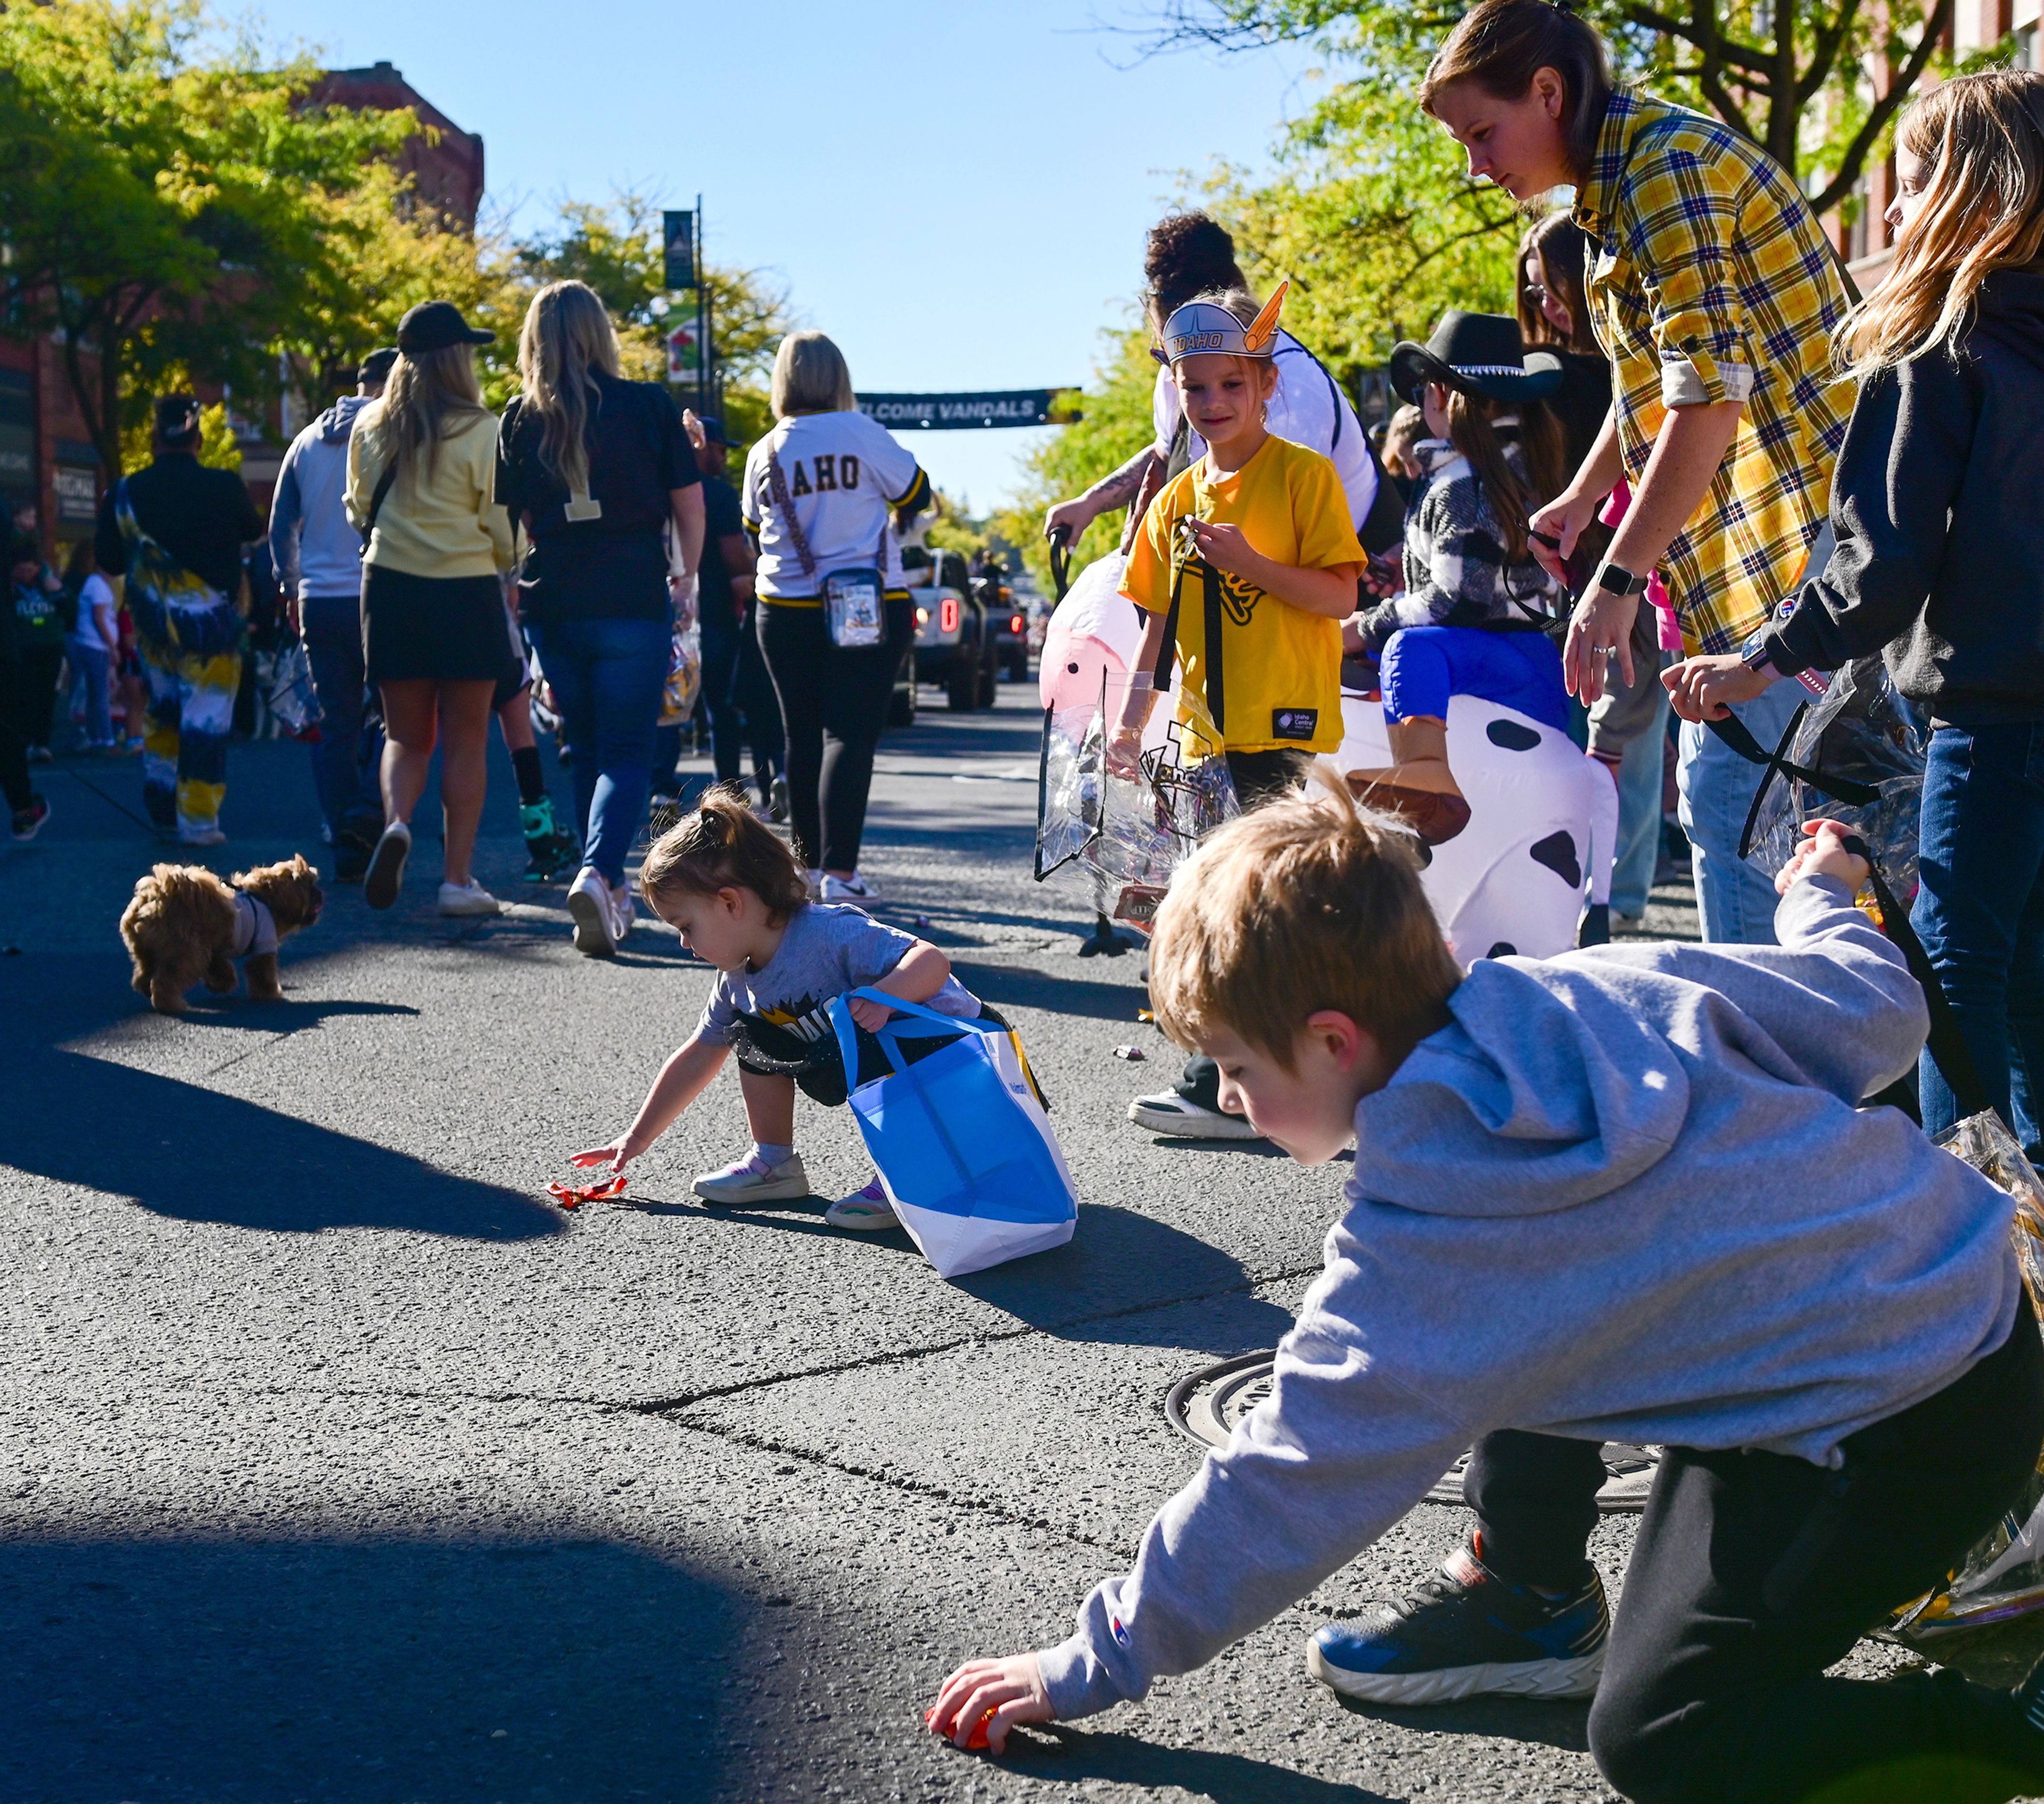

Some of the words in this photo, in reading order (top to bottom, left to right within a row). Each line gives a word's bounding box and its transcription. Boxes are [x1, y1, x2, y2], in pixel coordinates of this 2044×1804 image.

[1174, 332, 1223, 354] IDAHO
[857, 402, 935, 419] LCOME
[939, 400, 1035, 419] VANDALS
